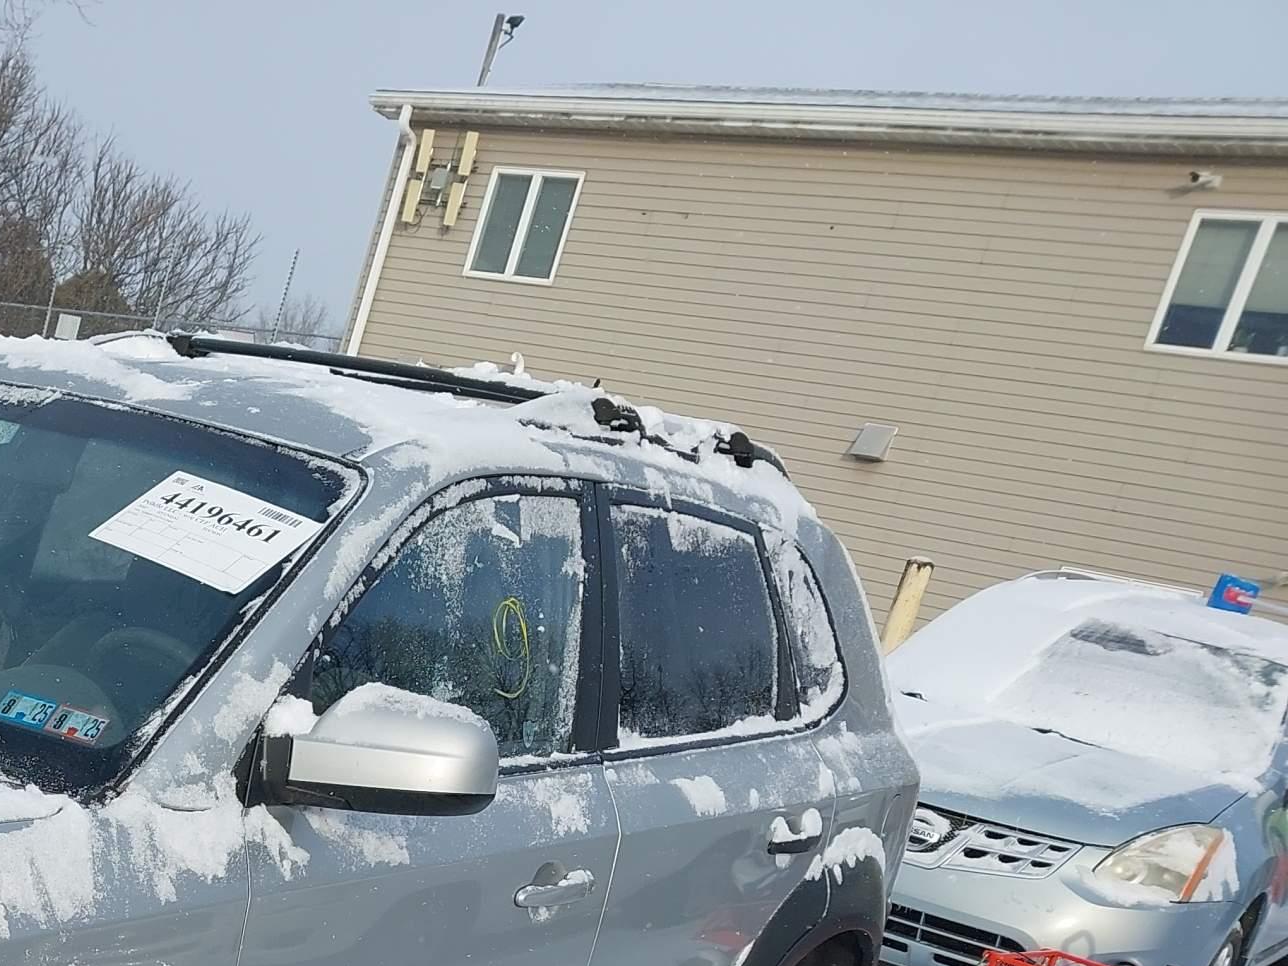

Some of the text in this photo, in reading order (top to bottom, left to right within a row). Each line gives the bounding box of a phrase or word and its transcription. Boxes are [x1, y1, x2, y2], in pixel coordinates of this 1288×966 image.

[160, 491, 282, 544] 44196461
[1, 698, 54, 723] 8 25
[53, 713, 106, 739] 8 25
